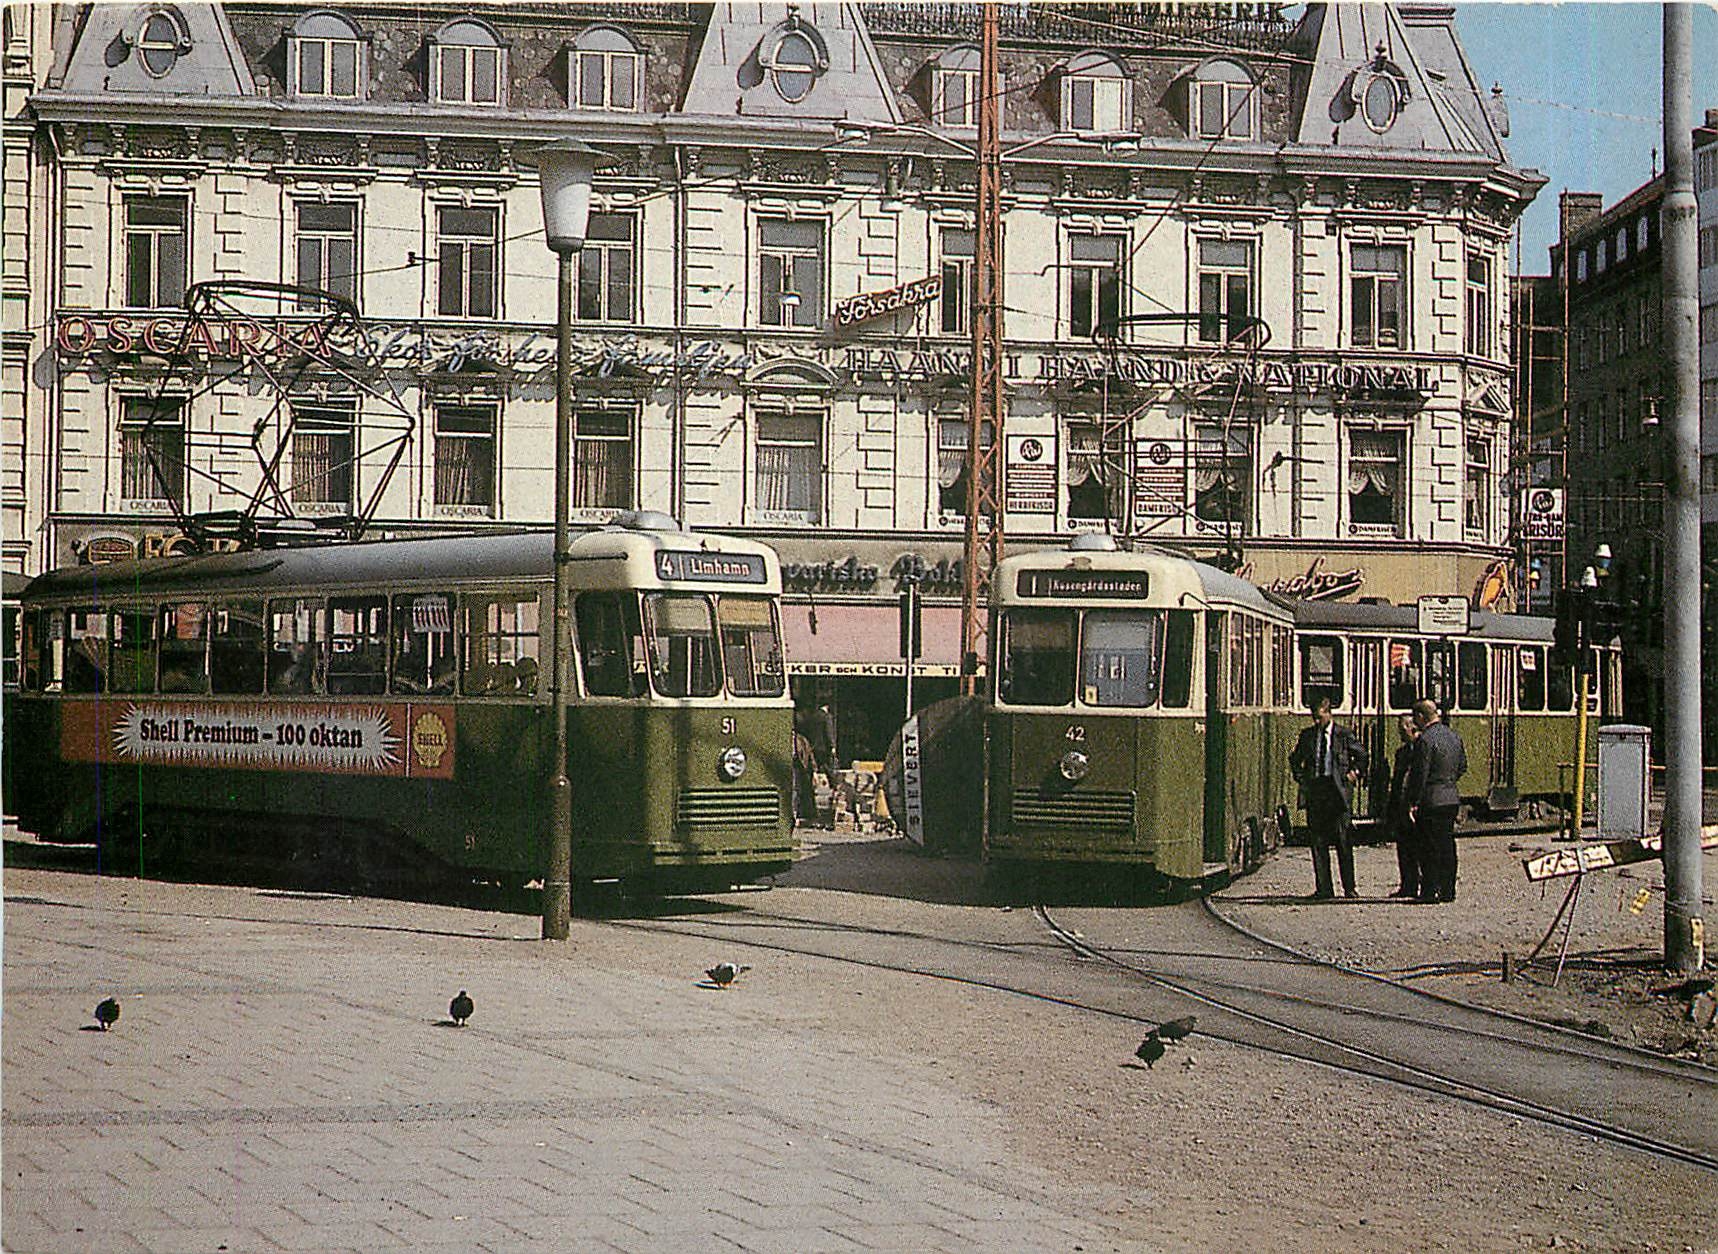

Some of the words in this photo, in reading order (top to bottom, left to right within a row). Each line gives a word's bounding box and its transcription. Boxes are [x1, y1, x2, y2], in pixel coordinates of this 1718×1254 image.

[58, 316, 332, 358] OSCARIA
[1232, 360, 1441, 392] NATIONAL
[300, 503, 341, 514] OSCARIA
[440, 506, 483, 517] OSCARIA
[763, 511, 805, 522] OSCARIA
[662, 553, 675, 577] 4
[690, 558, 751, 577] Limhamn
[140, 718, 179, 743] Shell
[183, 719, 259, 745] Premium
[275, 723, 306, 747] 100
[309, 722, 364, 749] oktan
[721, 717, 736, 735] 51
[1065, 725, 1086, 741] 42
[904, 733, 921, 826] SIEVERT
